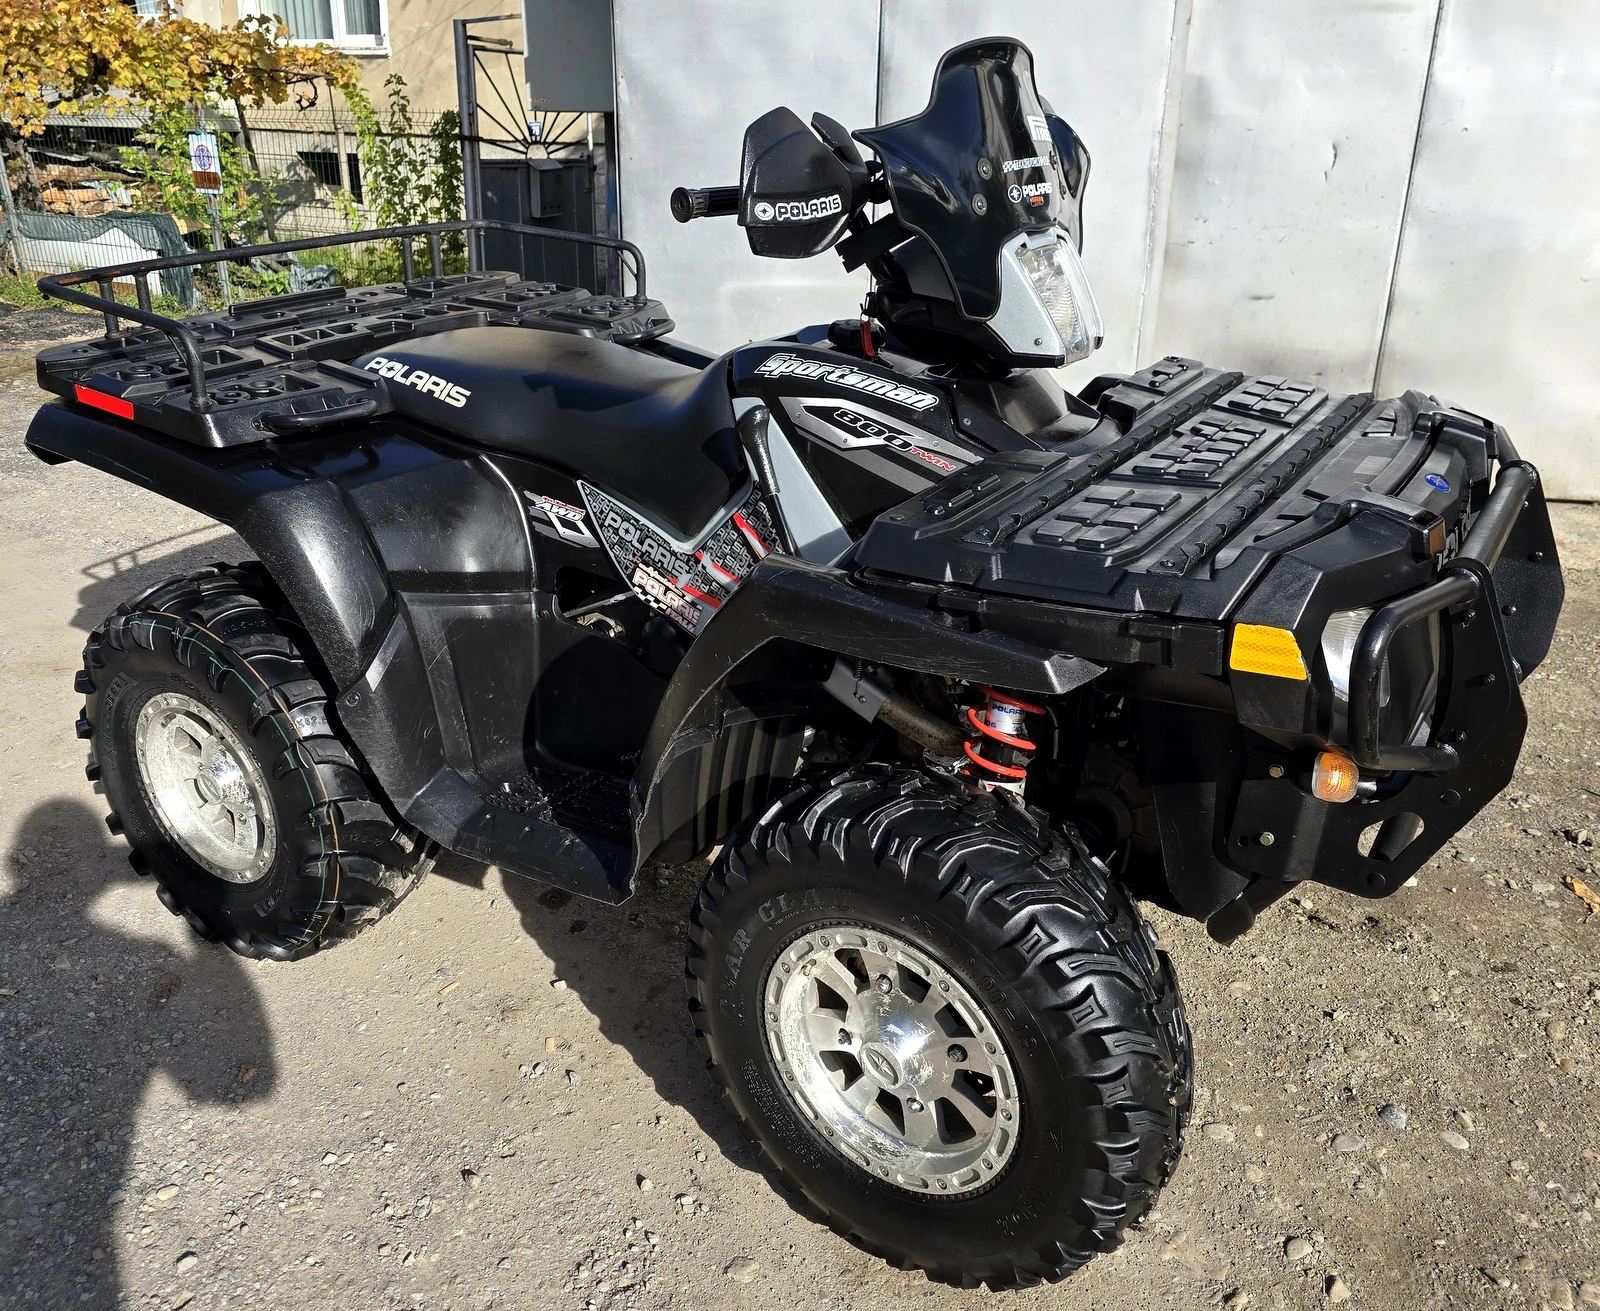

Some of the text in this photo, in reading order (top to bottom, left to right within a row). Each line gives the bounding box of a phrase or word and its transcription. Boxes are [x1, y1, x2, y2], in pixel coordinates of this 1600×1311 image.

[776, 194, 842, 221] POLARIS
[364, 357, 472, 408] POLARIS
[754, 353, 939, 412] Sportsman
[834, 408, 956, 472] 800 TWIN
[533, 502, 584, 521] AWD
[604, 510, 690, 577] POLARIS
[632, 568, 701, 623] POLARIS
